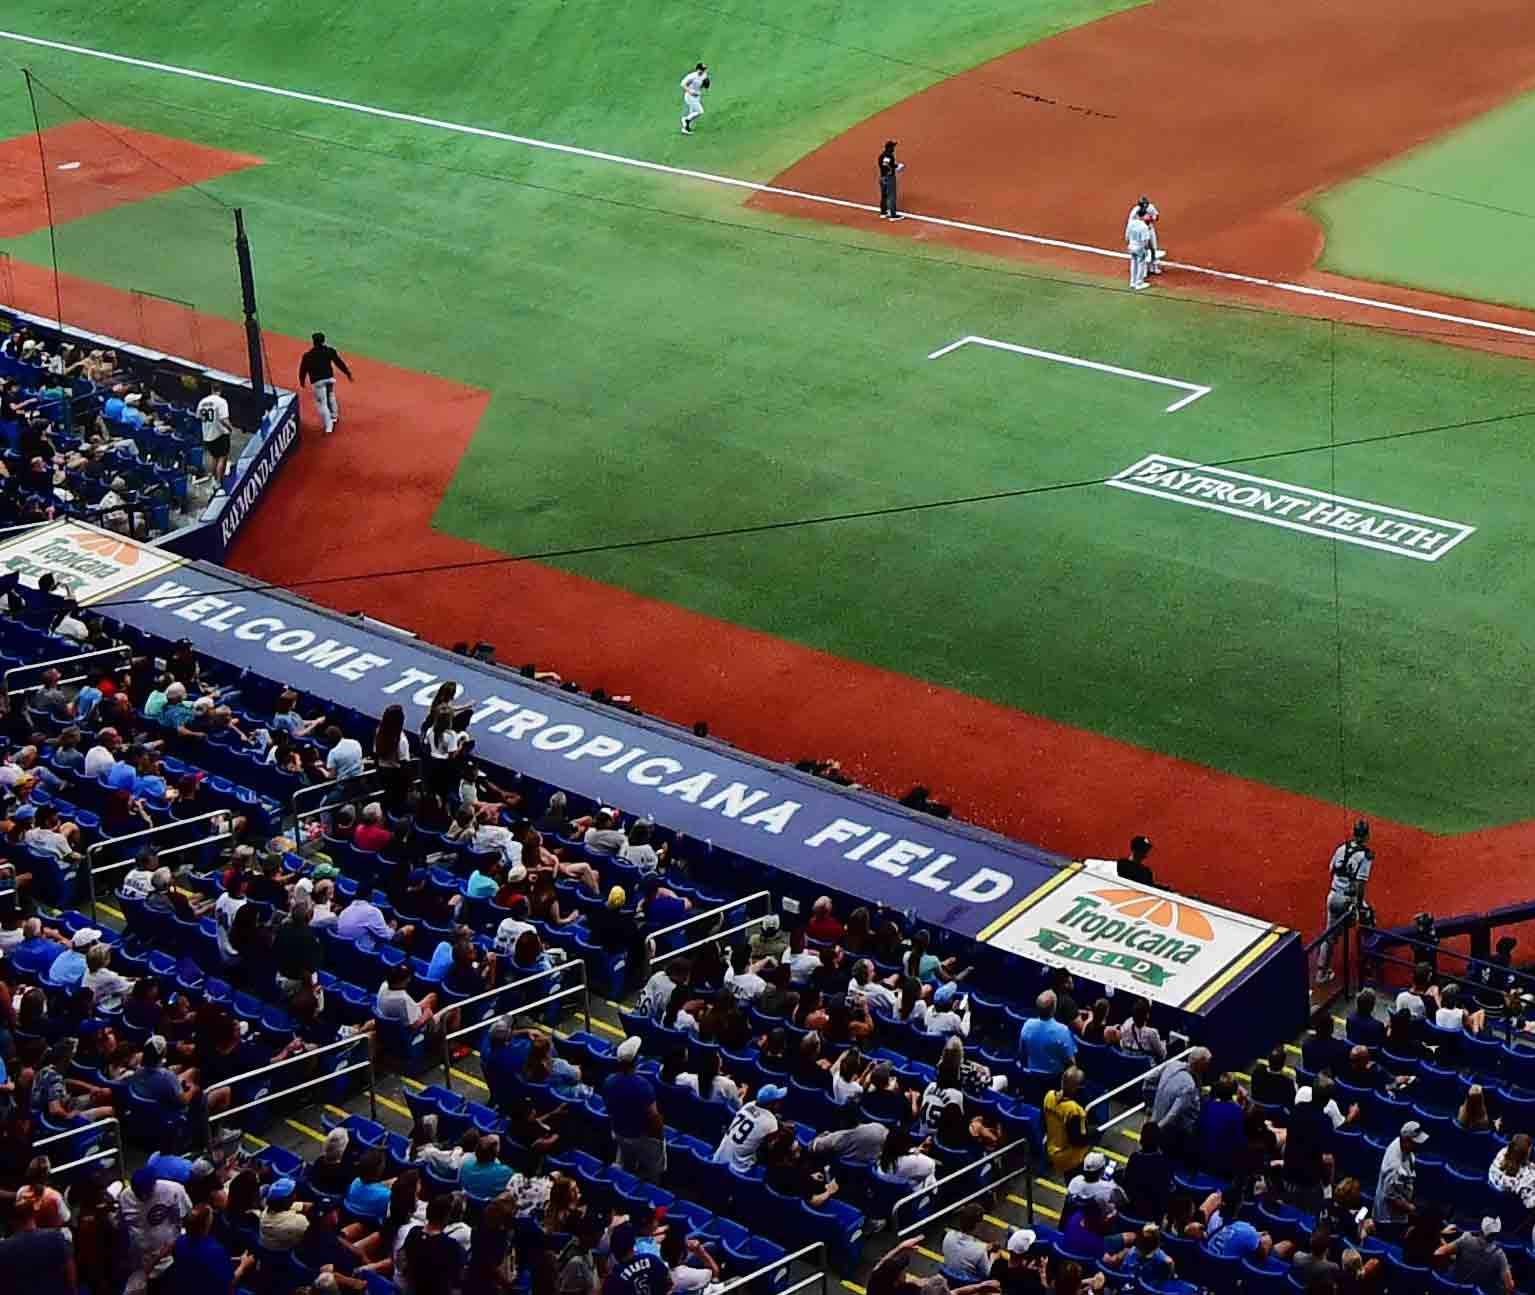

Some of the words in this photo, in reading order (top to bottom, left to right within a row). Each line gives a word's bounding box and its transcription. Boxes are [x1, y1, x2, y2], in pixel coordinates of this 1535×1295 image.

[221, 471, 269, 546] RAYMOND
[267, 414, 298, 475] JAMES
[1135, 462, 1310, 517] BAYFRONT
[1300, 503, 1448, 551] HEALTH
[140, 580, 391, 683] WELCOME
[472, 693, 803, 835] TROPICANA
[804, 817, 1015, 905] FIELD
[1050, 941, 1152, 974] FIELD
[1057, 895, 1201, 964] Tropicana
